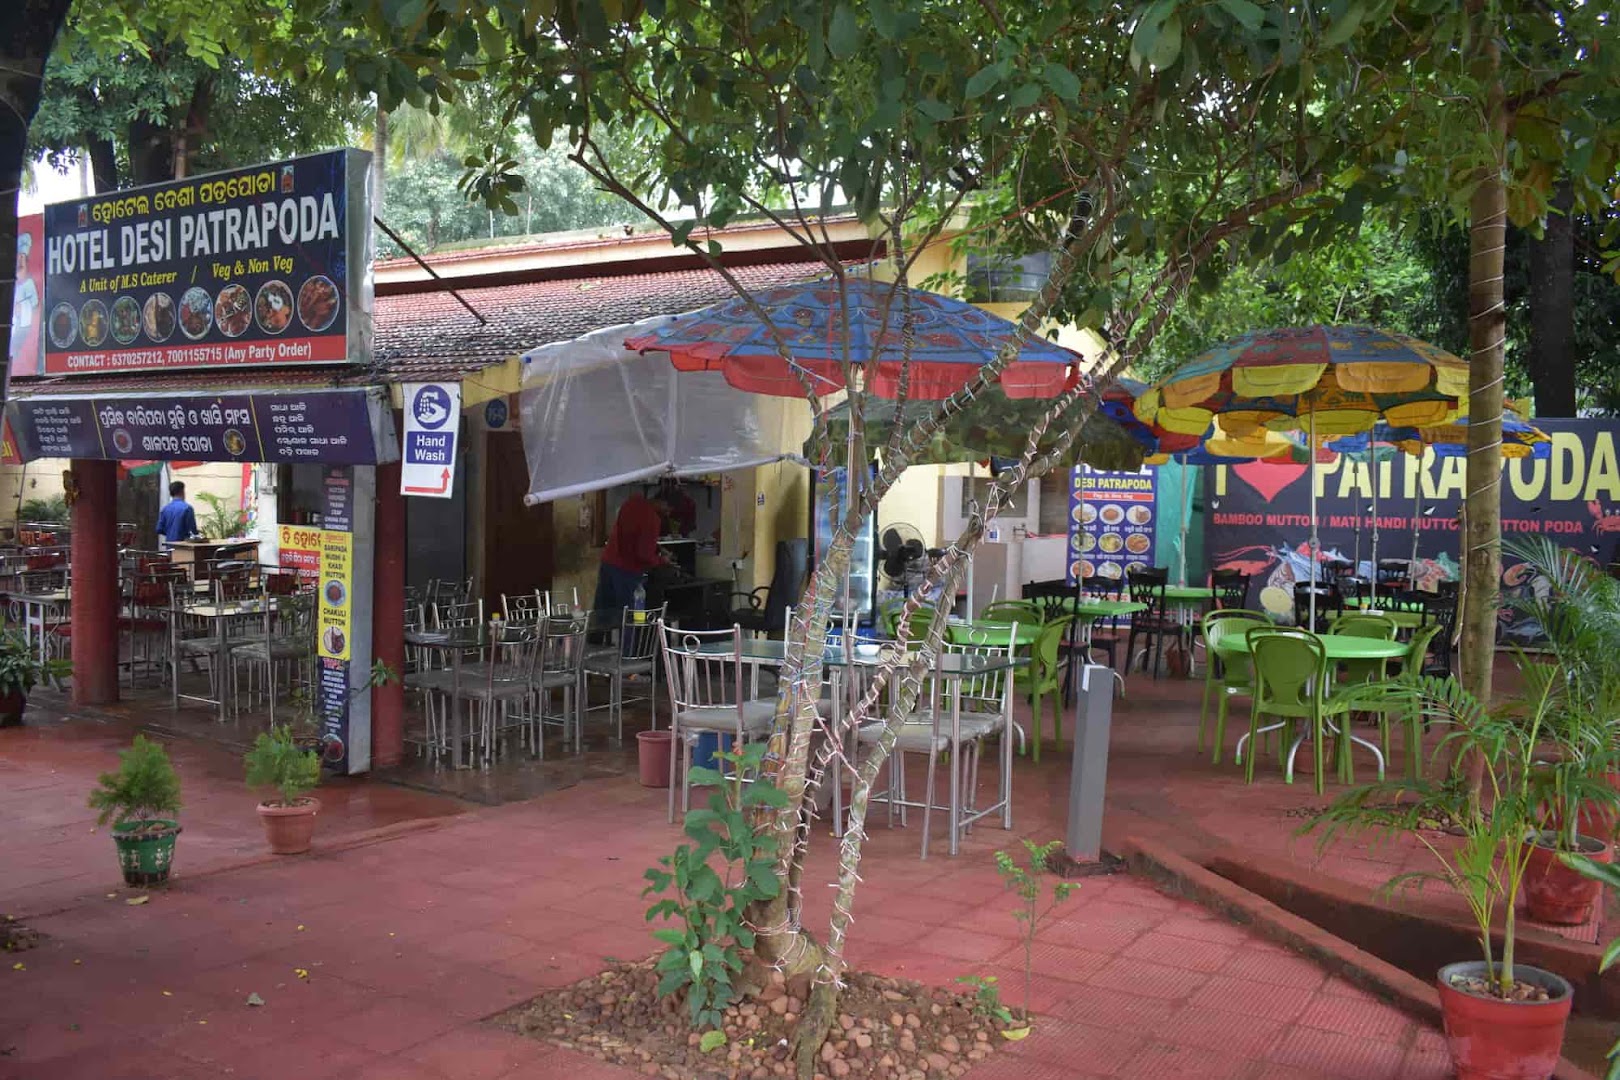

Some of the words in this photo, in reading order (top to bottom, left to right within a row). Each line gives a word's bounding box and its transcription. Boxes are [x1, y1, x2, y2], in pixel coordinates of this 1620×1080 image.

[49, 229, 115, 275] HOTEL
[121, 214, 171, 267] DESI
[180, 192, 339, 259] PATRAPODA
[80, 280, 87, 293] A
[89, 277, 107, 292] Unit
[109, 276, 120, 293] of
[121, 274, 137, 288] M.S
[141, 271, 177, 286] Caterer
[191, 266, 197, 284] /
[212, 262, 231, 280] Veg
[234, 263, 245, 275] &
[249, 259, 269, 274] Non
[273, 256, 294, 273] Veg
[67, 354, 105, 368] CONTACT
[225, 345, 246, 363] (Any
[249, 343, 275, 361] Party
[278, 342, 311, 359] Order)
[188, 410, 198, 425] ଓ
[417, 435, 446, 447] Hand
[415, 449, 446, 461] Wash
[1074, 477, 1096, 488] DESI
[1098, 478, 1152, 490] PATRAPODA
[1213, 512, 1263, 526] BAMBOO
[1266, 513, 1319, 527] MUTTO
[1330, 514, 1361, 529] MATI
[1364, 515, 1406, 530] HANDI
[1544, 521, 1584, 534] PODA
[323, 607, 347, 617] CHAKULI
